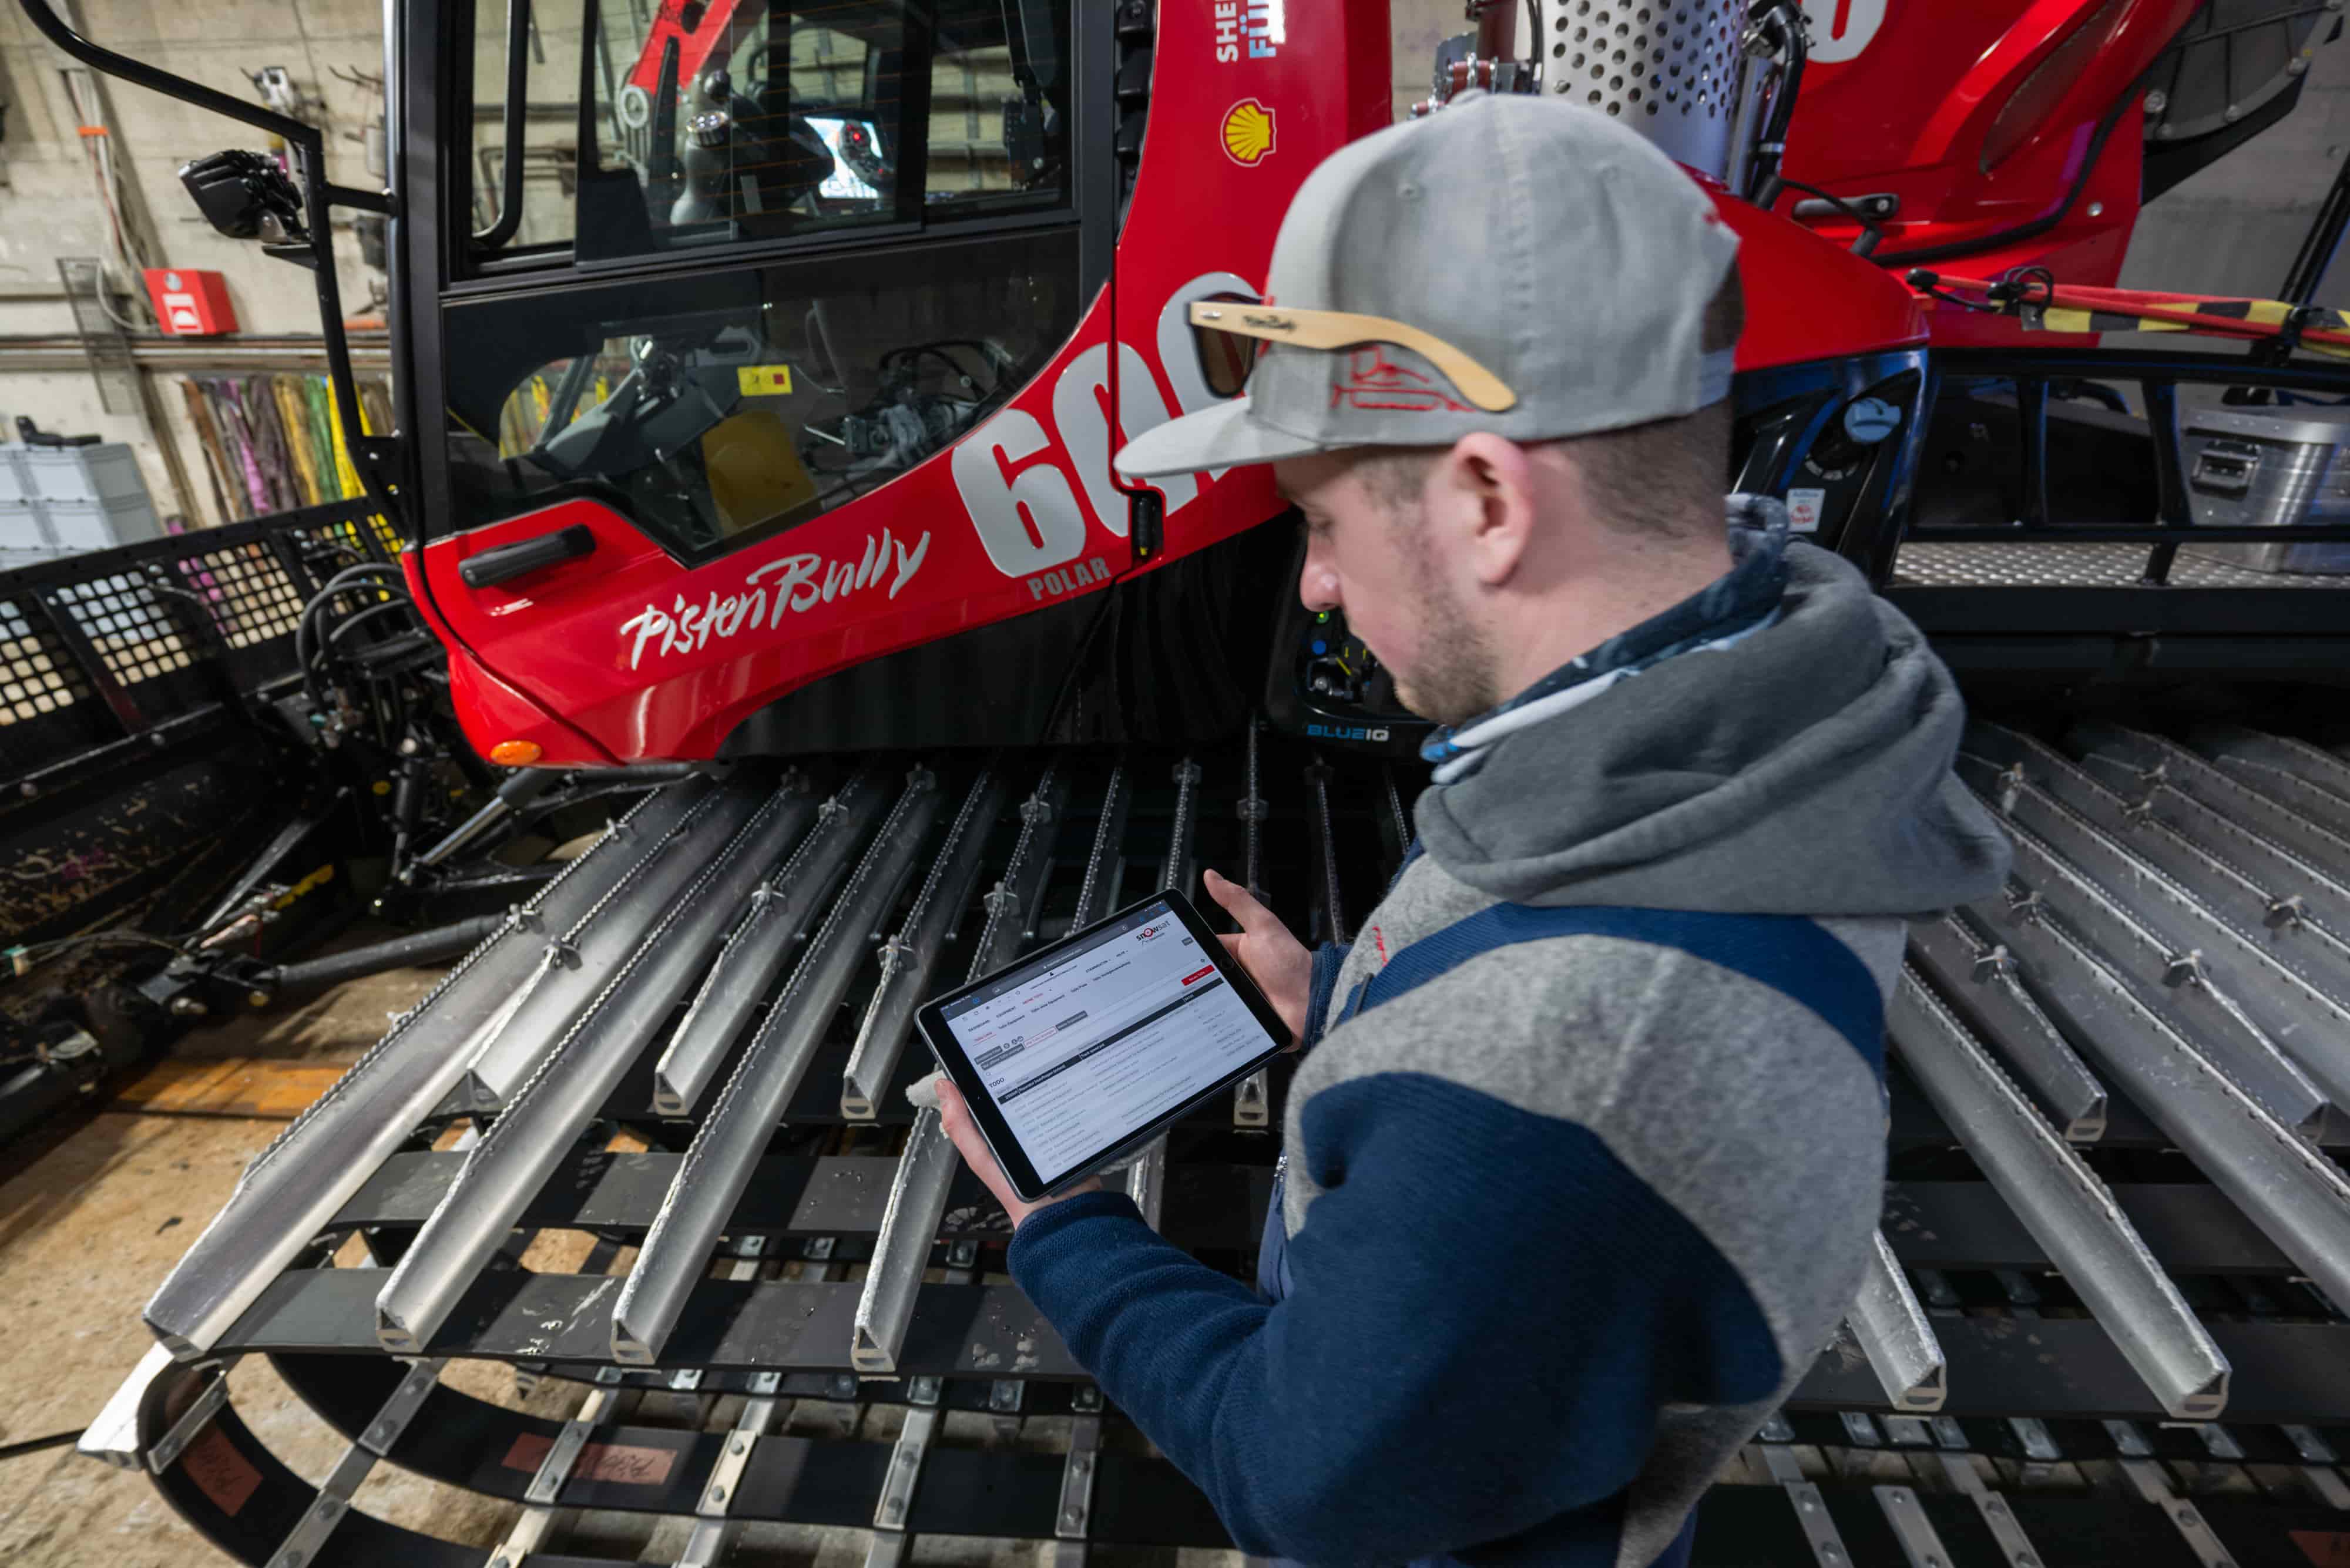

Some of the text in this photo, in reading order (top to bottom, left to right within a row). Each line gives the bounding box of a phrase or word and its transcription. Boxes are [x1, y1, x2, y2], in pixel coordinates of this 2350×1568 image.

[1214, 0, 1239, 63] SHE
[1026, 558, 1112, 601] POLAR
[988, 1077, 1005, 1089] TODO
